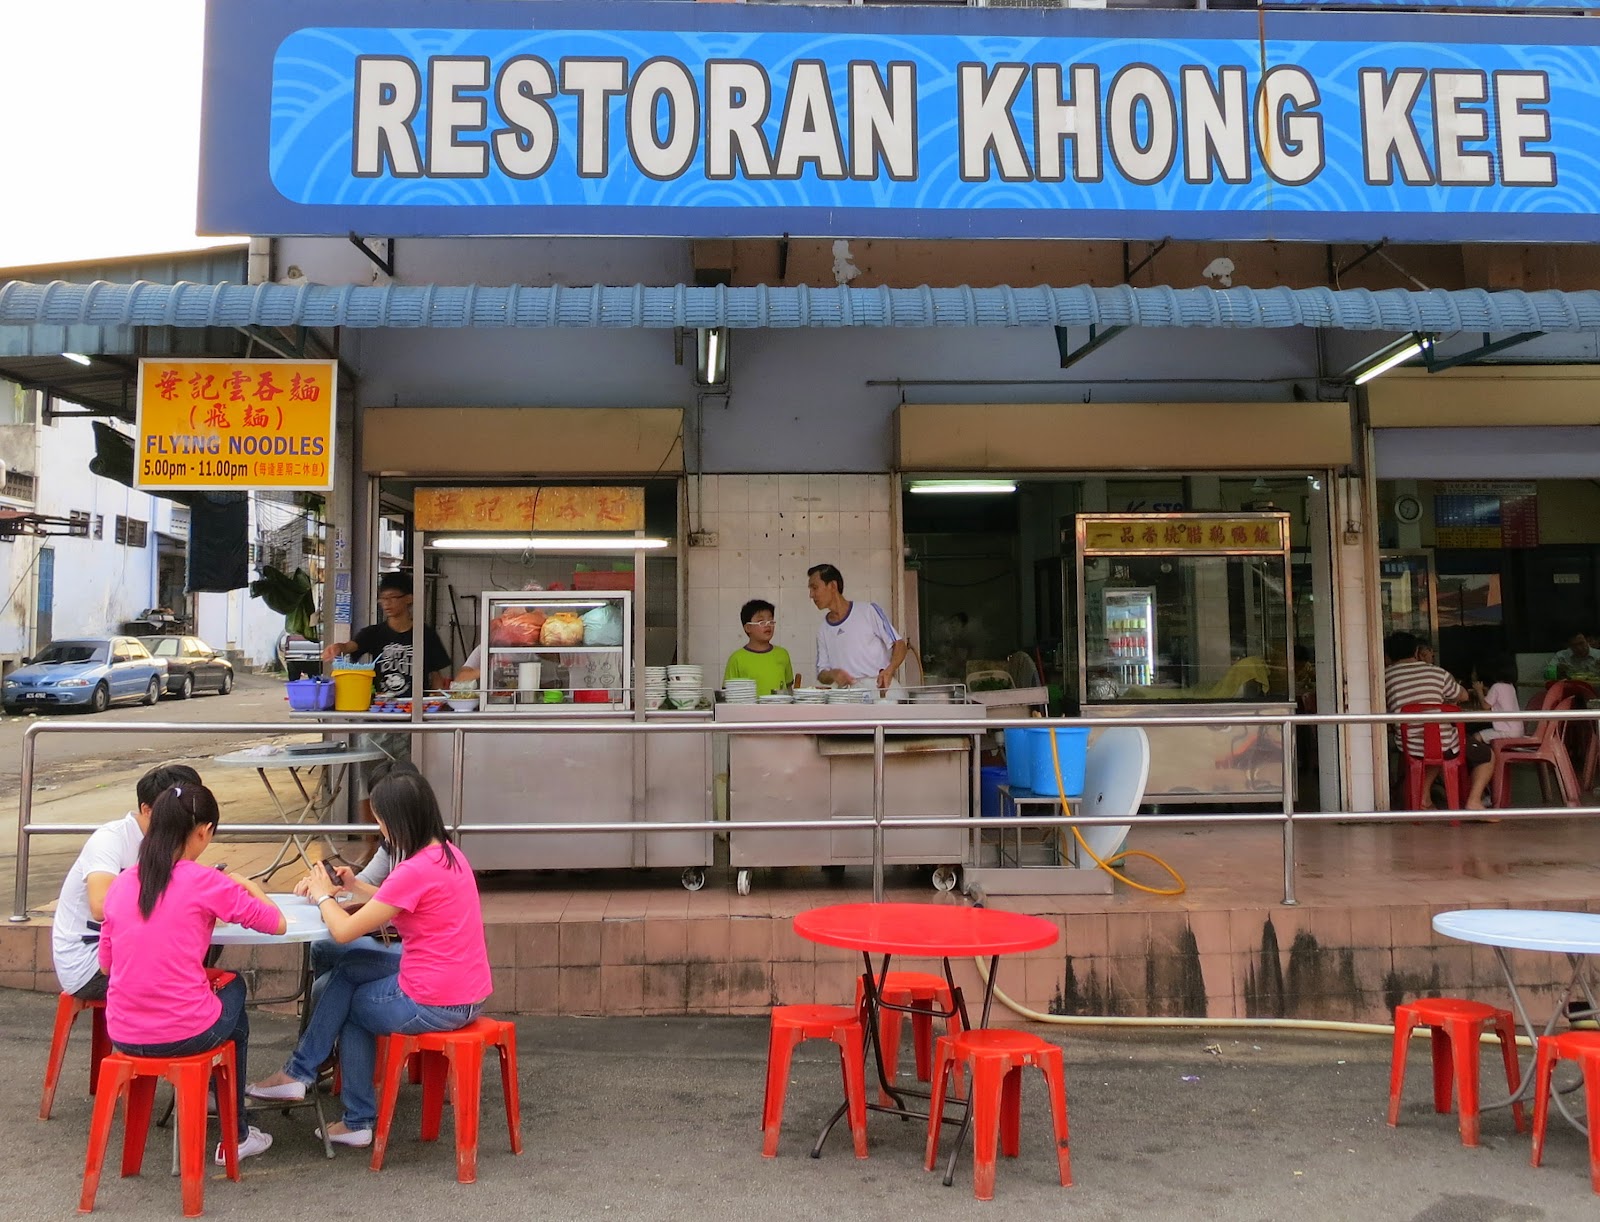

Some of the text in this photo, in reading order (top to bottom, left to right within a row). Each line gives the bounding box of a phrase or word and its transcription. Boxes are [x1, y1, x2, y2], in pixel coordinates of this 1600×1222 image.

[352, 55, 1557, 187] RESTORAN KHONG KEE
[155, 370, 320, 402] 葉記雲吞麵
[146, 435, 324, 456] FLYING NOODLES
[144, 459, 186, 480] 5.00pm
[199, 460, 248, 480] 11.00pm
